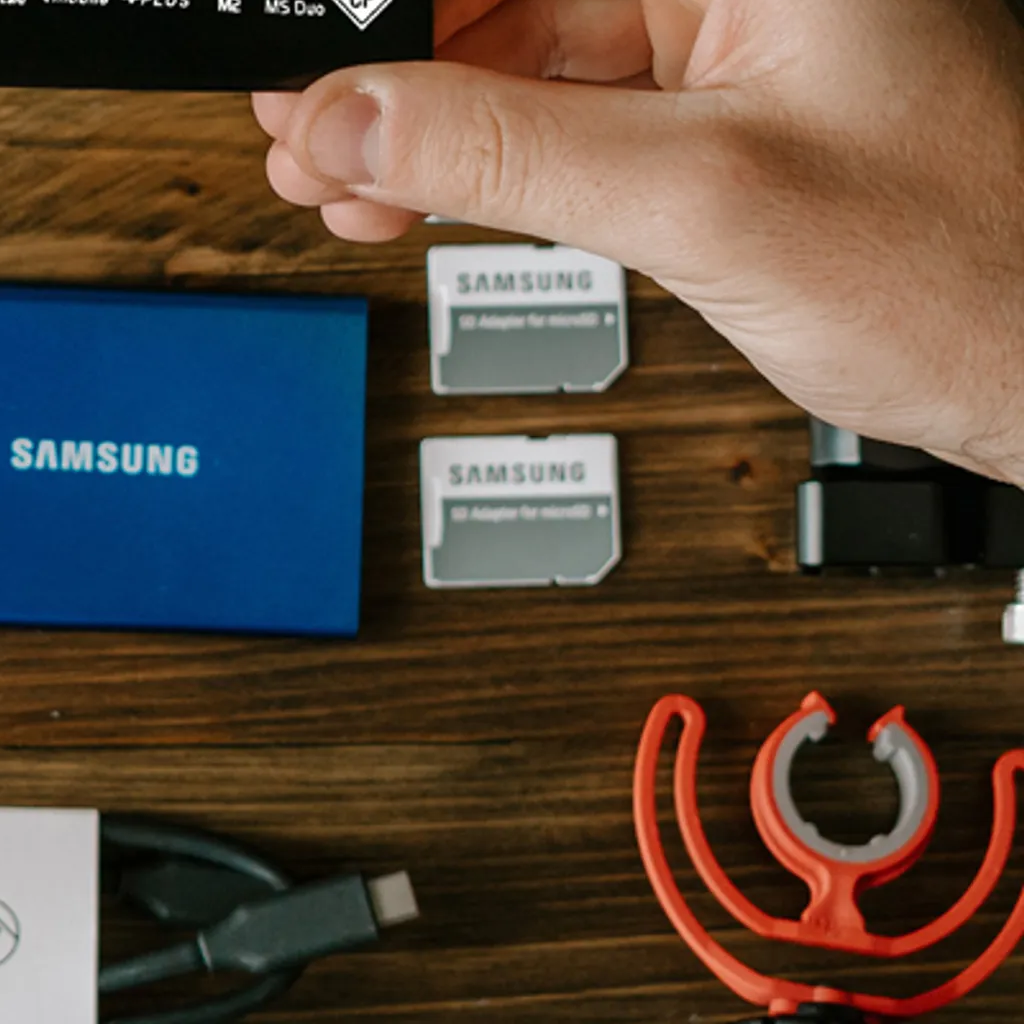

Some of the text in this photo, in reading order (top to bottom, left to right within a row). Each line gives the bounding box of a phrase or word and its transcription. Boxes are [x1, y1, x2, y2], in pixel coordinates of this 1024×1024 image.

[293, 0, 327, 18] Duo
[456, 269, 595, 295] SAMSUNG
[9, 436, 200, 478] SAMSUNG
[447, 461, 589, 487] SAMSUNG
